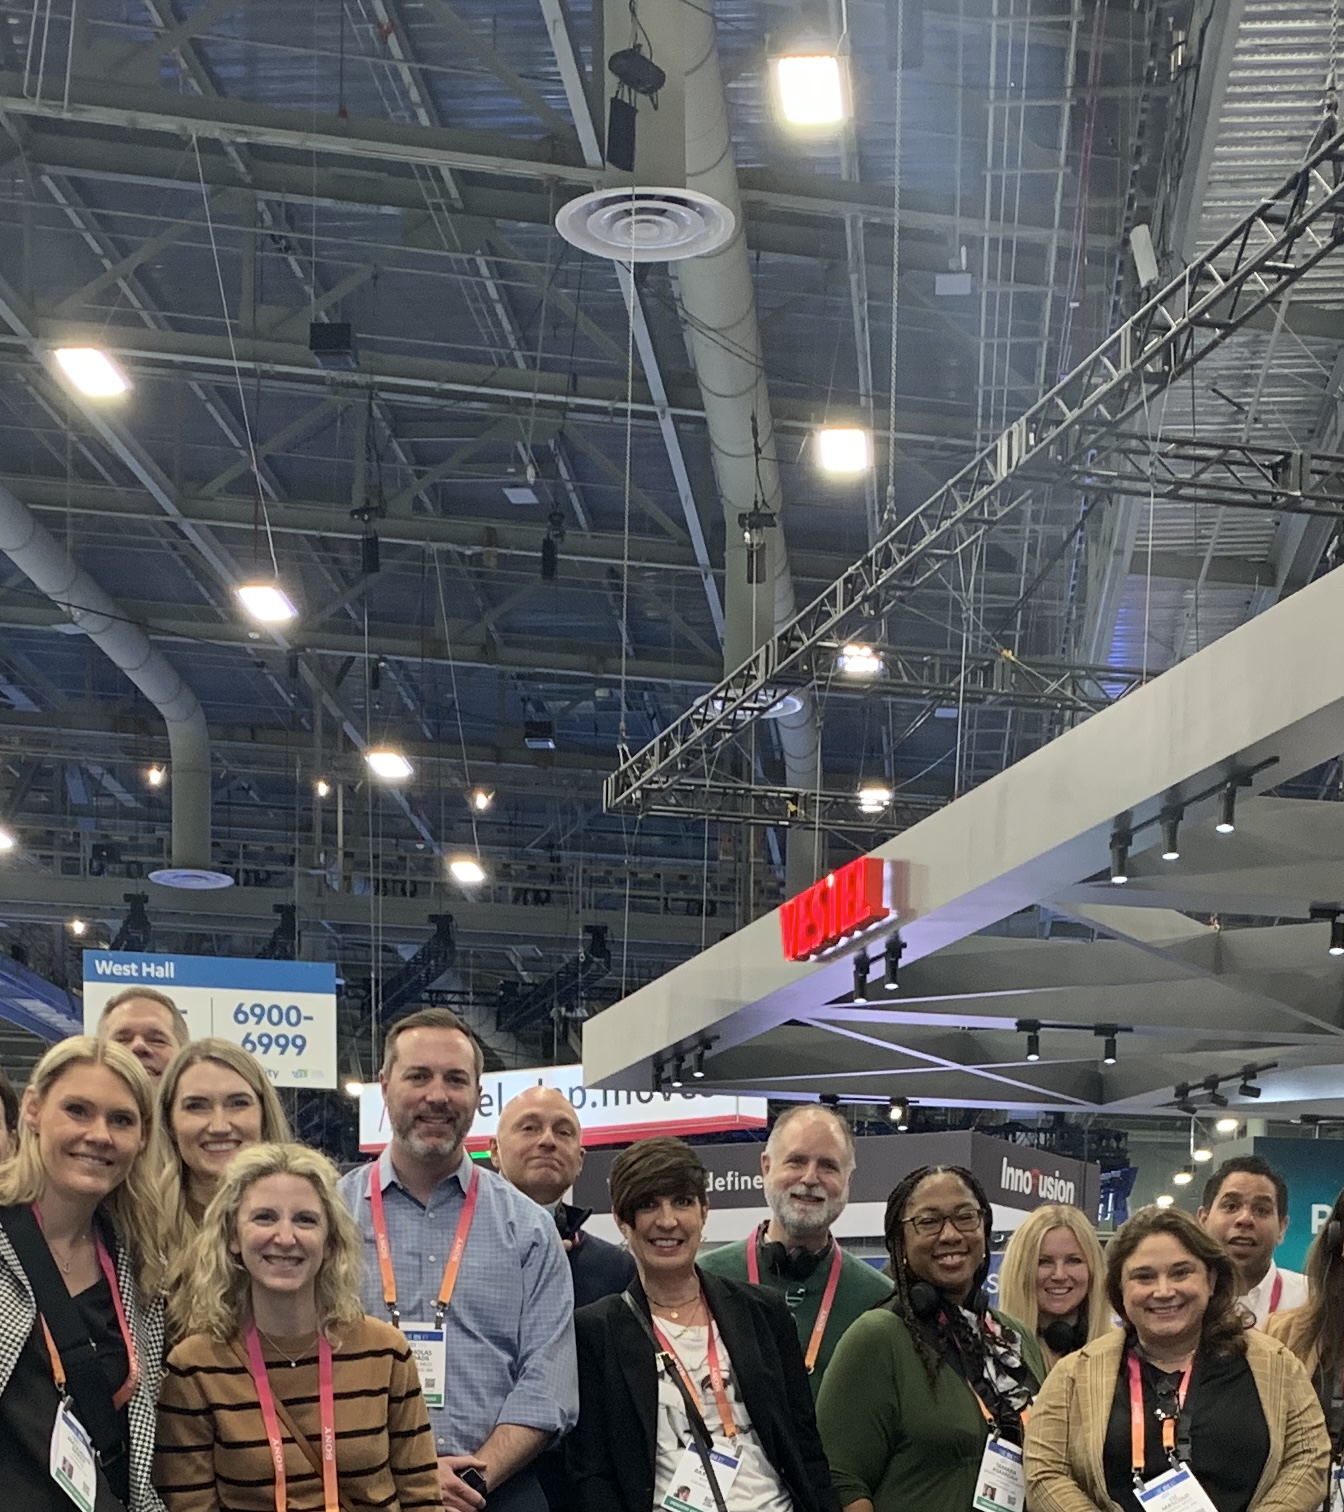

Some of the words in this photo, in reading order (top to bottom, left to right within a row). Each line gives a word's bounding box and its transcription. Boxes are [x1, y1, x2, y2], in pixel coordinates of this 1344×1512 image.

[94, 959, 139, 977] West
[142, 961, 175, 979] Hall
[233, 1003, 314, 1027] 6900-
[241, 1032, 307, 1056] 6999
[272, 1437, 284, 1472] SONY
[324, 1426, 334, 1461] SONY
